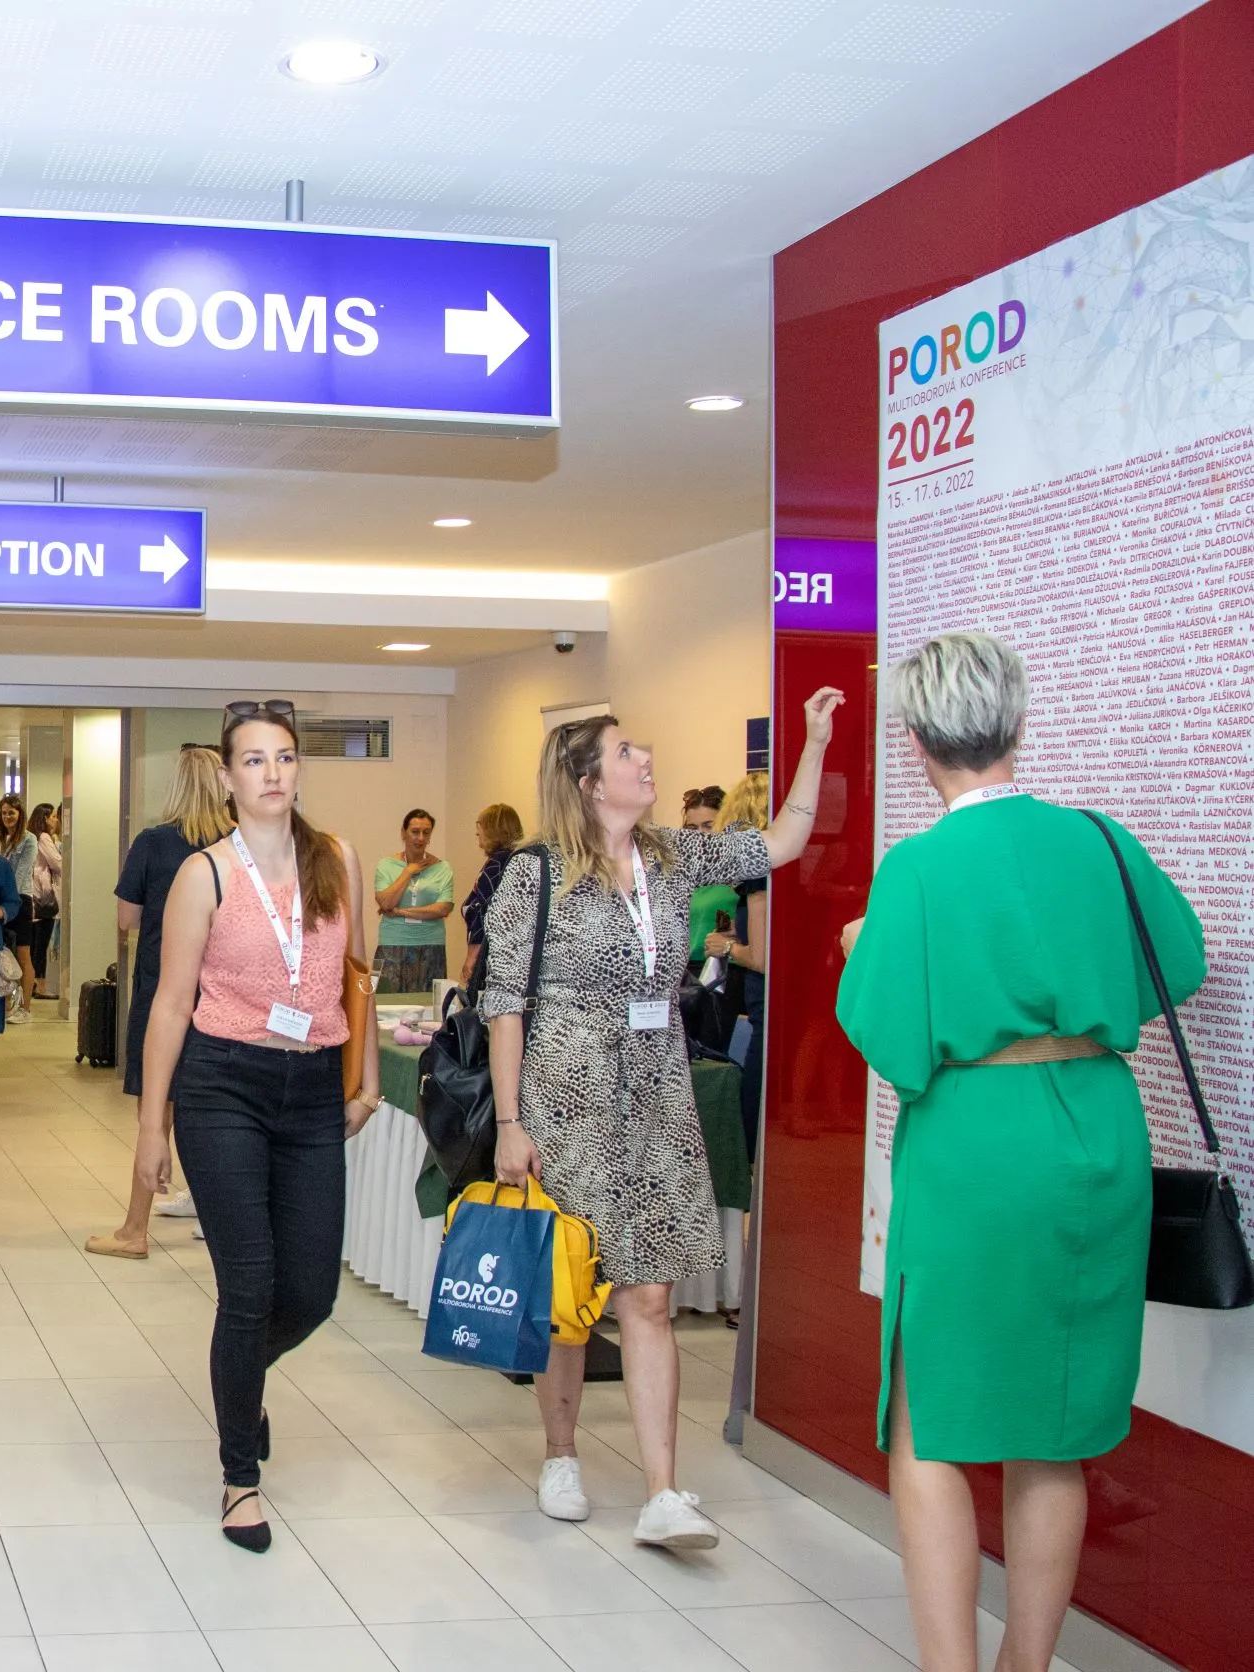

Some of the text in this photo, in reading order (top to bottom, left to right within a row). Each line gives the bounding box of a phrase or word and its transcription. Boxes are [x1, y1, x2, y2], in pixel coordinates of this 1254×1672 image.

[90, 284, 379, 357] ROOMS
[888, 299, 1027, 396] POROD
[887, 353, 1027, 415] MULTIOBOROVÁ KONFERENCE
[887, 397, 976, 470] 2022
[1150, 463, 1169, 473] Lenka
[1221, 444, 1240, 454] Lucie
[1178, 466, 1204, 477] Barbora
[946, 470, 974, 493] 2022
[1188, 477, 1209, 487] Tereza
[1132, 527, 1156, 537] Monika
[1214, 509, 1240, 520] Milada
[1119, 541, 1148, 552] Veronika
[1183, 542, 1200, 552] Lucie
[1124, 565, 1150, 575] Radmila
[1132, 577, 1148, 586] Petra
[1205, 576, 1223, 585] Karel
[1097, 605, 1124, 616] Michaela
[1170, 594, 1194, 604] Andrea
[1110, 616, 1138, 625] Miroslav
[1143, 610, 1171, 621] GREGOR
[1144, 622, 1174, 633] Dominika
[1223, 614, 1236, 622] Jan
[1158, 634, 1174, 643] Alice
[1179, 627, 1232, 640] HASELBERGER
[1195, 643, 1209, 651] Petr
[1213, 638, 1247, 649] HERMAN
[1117, 664, 1139, 673] Helena
[1121, 675, 1150, 684] HRUBAN
[1159, 671, 1181, 680] Zuzana
[1107, 702, 1121, 710] Jana
[1177, 694, 1204, 703] Barbora
[1193, 705, 1211, 717] Olga
[1120, 719, 1211, 733] Monika KARCH Martina
[1181, 731, 1208, 741] Barbara
[1159, 745, 1187, 755] Veronika
[1153, 758, 1186, 767] Alexandra
[982, 785, 1014, 798] POROD
[1185, 782, 1213, 793] Dagmar
[1171, 808, 1199, 817] Ludmila
[1189, 820, 1220, 829] Rastislav
[1176, 847, 1204, 855] Adriana
[1196, 860, 1208, 868] Jan
[1198, 873, 1214, 881] Jana
[1187, 1025, 1211, 1036] Regina
[1149, 1094, 1177, 1106] Markéta
[1161, 1134, 1191, 1147] Michaela
[439, 1277, 518, 1308] POROD
[478, 1304, 513, 1316] KONFERENCE
